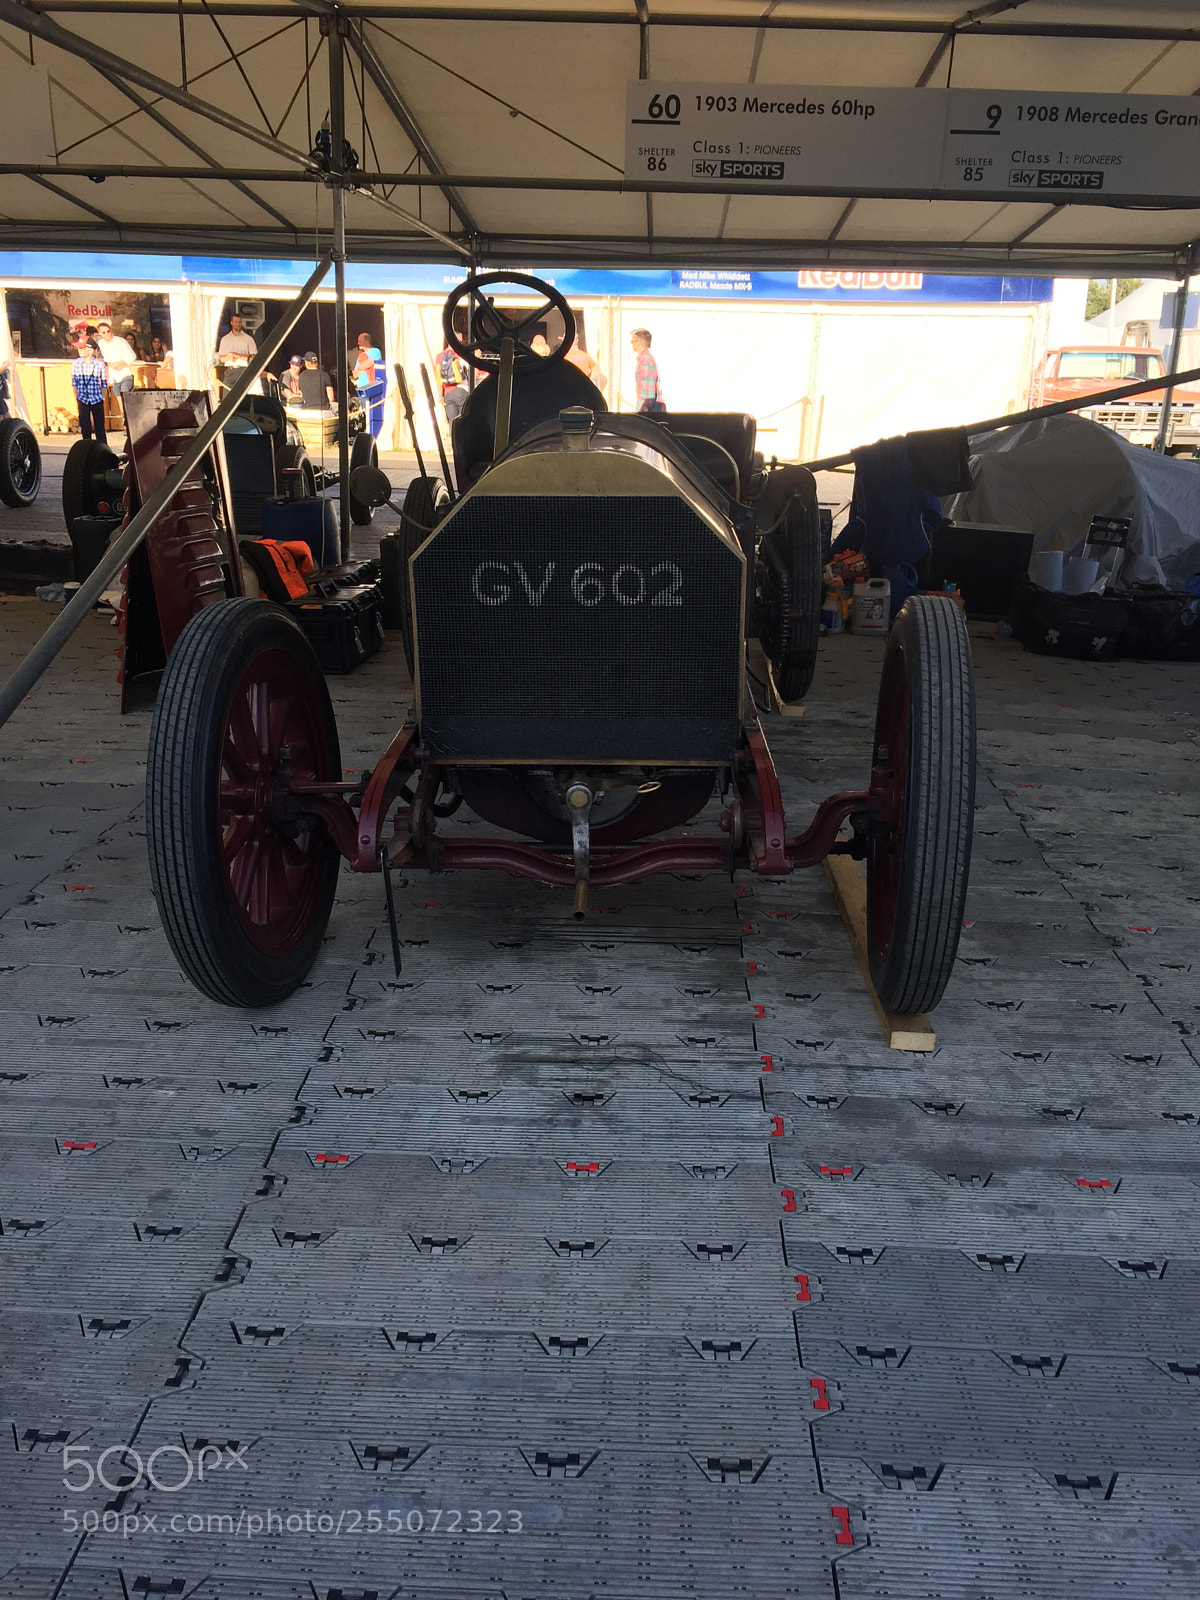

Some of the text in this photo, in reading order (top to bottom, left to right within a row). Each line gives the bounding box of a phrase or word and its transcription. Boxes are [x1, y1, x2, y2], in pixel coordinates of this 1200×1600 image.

[648, 94, 681, 119] 60
[695, 95, 875, 120] 1903 Mercedes 60hp
[986, 104, 1002, 129] 9
[1017, 105, 1200, 126] 1908 Mercedes Gran
[638, 147, 676, 156] SHELTER
[692, 140, 802, 156] Class 1: PIONEERS
[647, 156, 667, 171] 86
[955, 157, 993, 166] SHELTER
[1011, 150, 1122, 165] Class 1: PIONEERS
[695, 160, 782, 177] sky SPORTS
[963, 167, 984, 181] 85
[1012, 170, 1100, 186] sky SPORTS
[68, 304, 112, 317] Red Bull
[472, 560, 683, 606] GV 602
